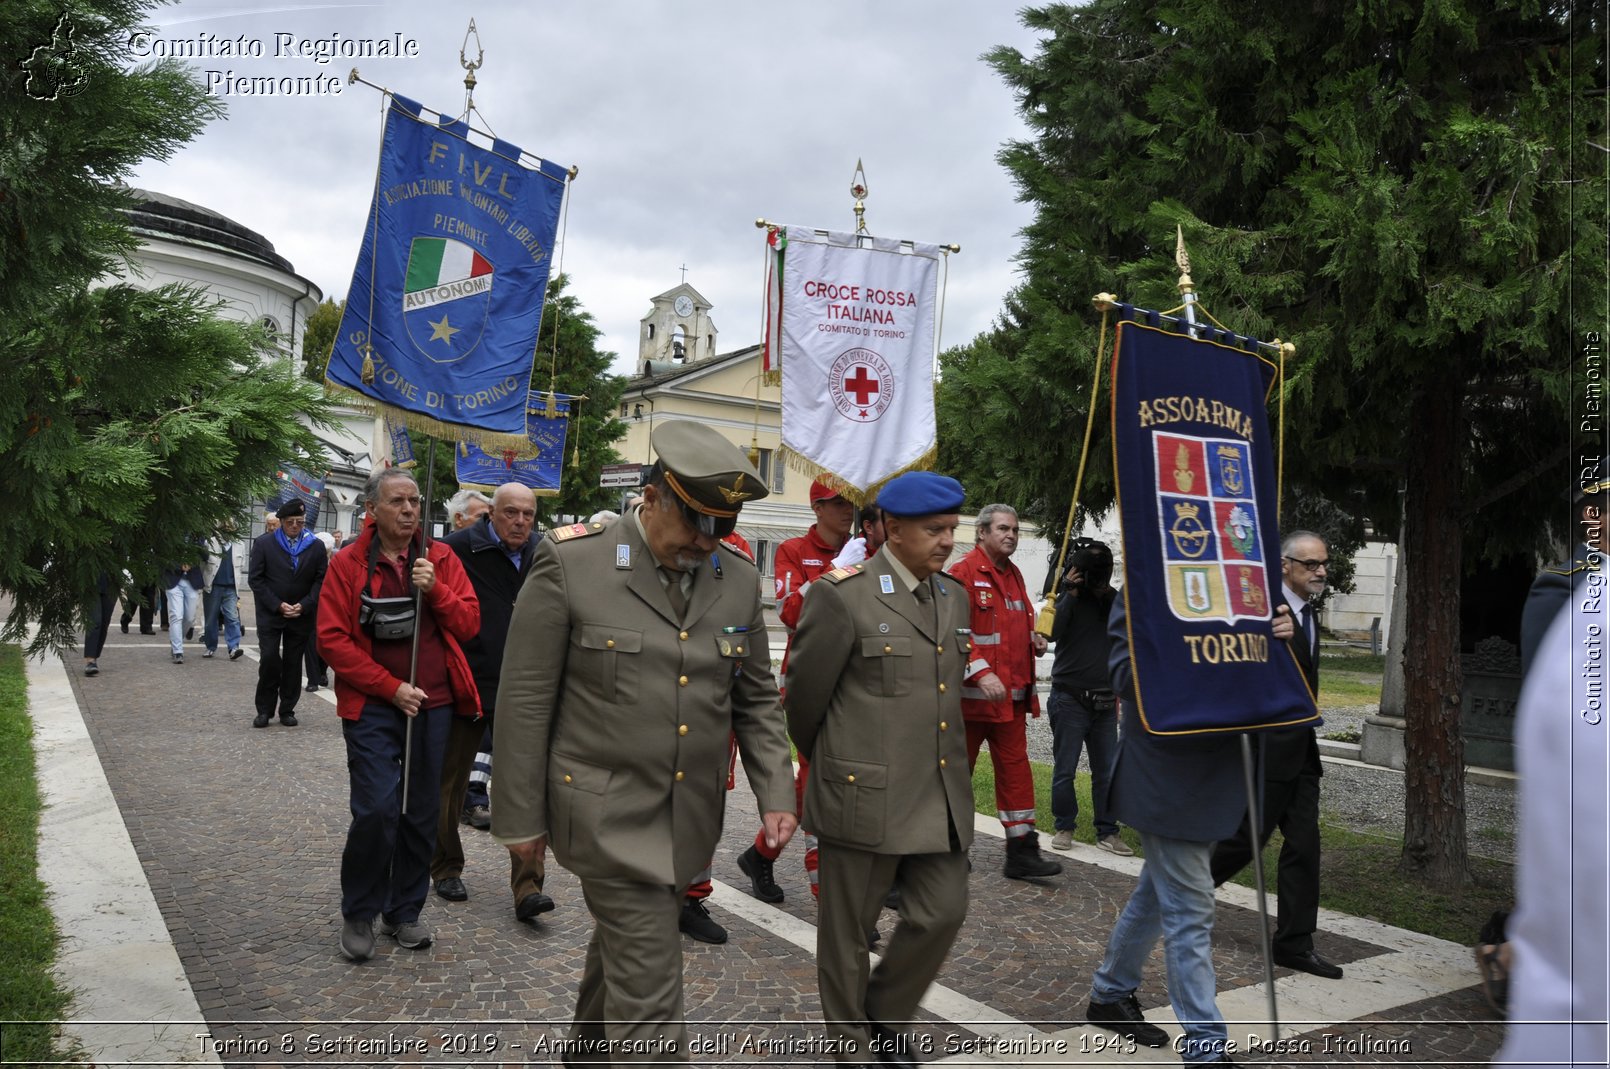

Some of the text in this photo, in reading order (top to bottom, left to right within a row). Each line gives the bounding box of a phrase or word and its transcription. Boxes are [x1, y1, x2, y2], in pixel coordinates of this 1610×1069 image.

[433, 213, 489, 248] PIEMONTE
[406, 278, 486, 308] AUTONOMI
[805, 281, 916, 307] CROCE ROSSA
[827, 304, 895, 325] ITALIANA
[818, 324, 905, 339] COMITATO DI TORINO
[349, 330, 519, 410] SEZIONE DI TORINO
[850, 351, 878, 366] GINEVRA
[882, 374, 892, 402] AGOSTO
[1139, 396, 1254, 442] ASSOARMA
[515, 462, 540, 471] TORINO
[1184, 633, 1269, 664] TORINO
